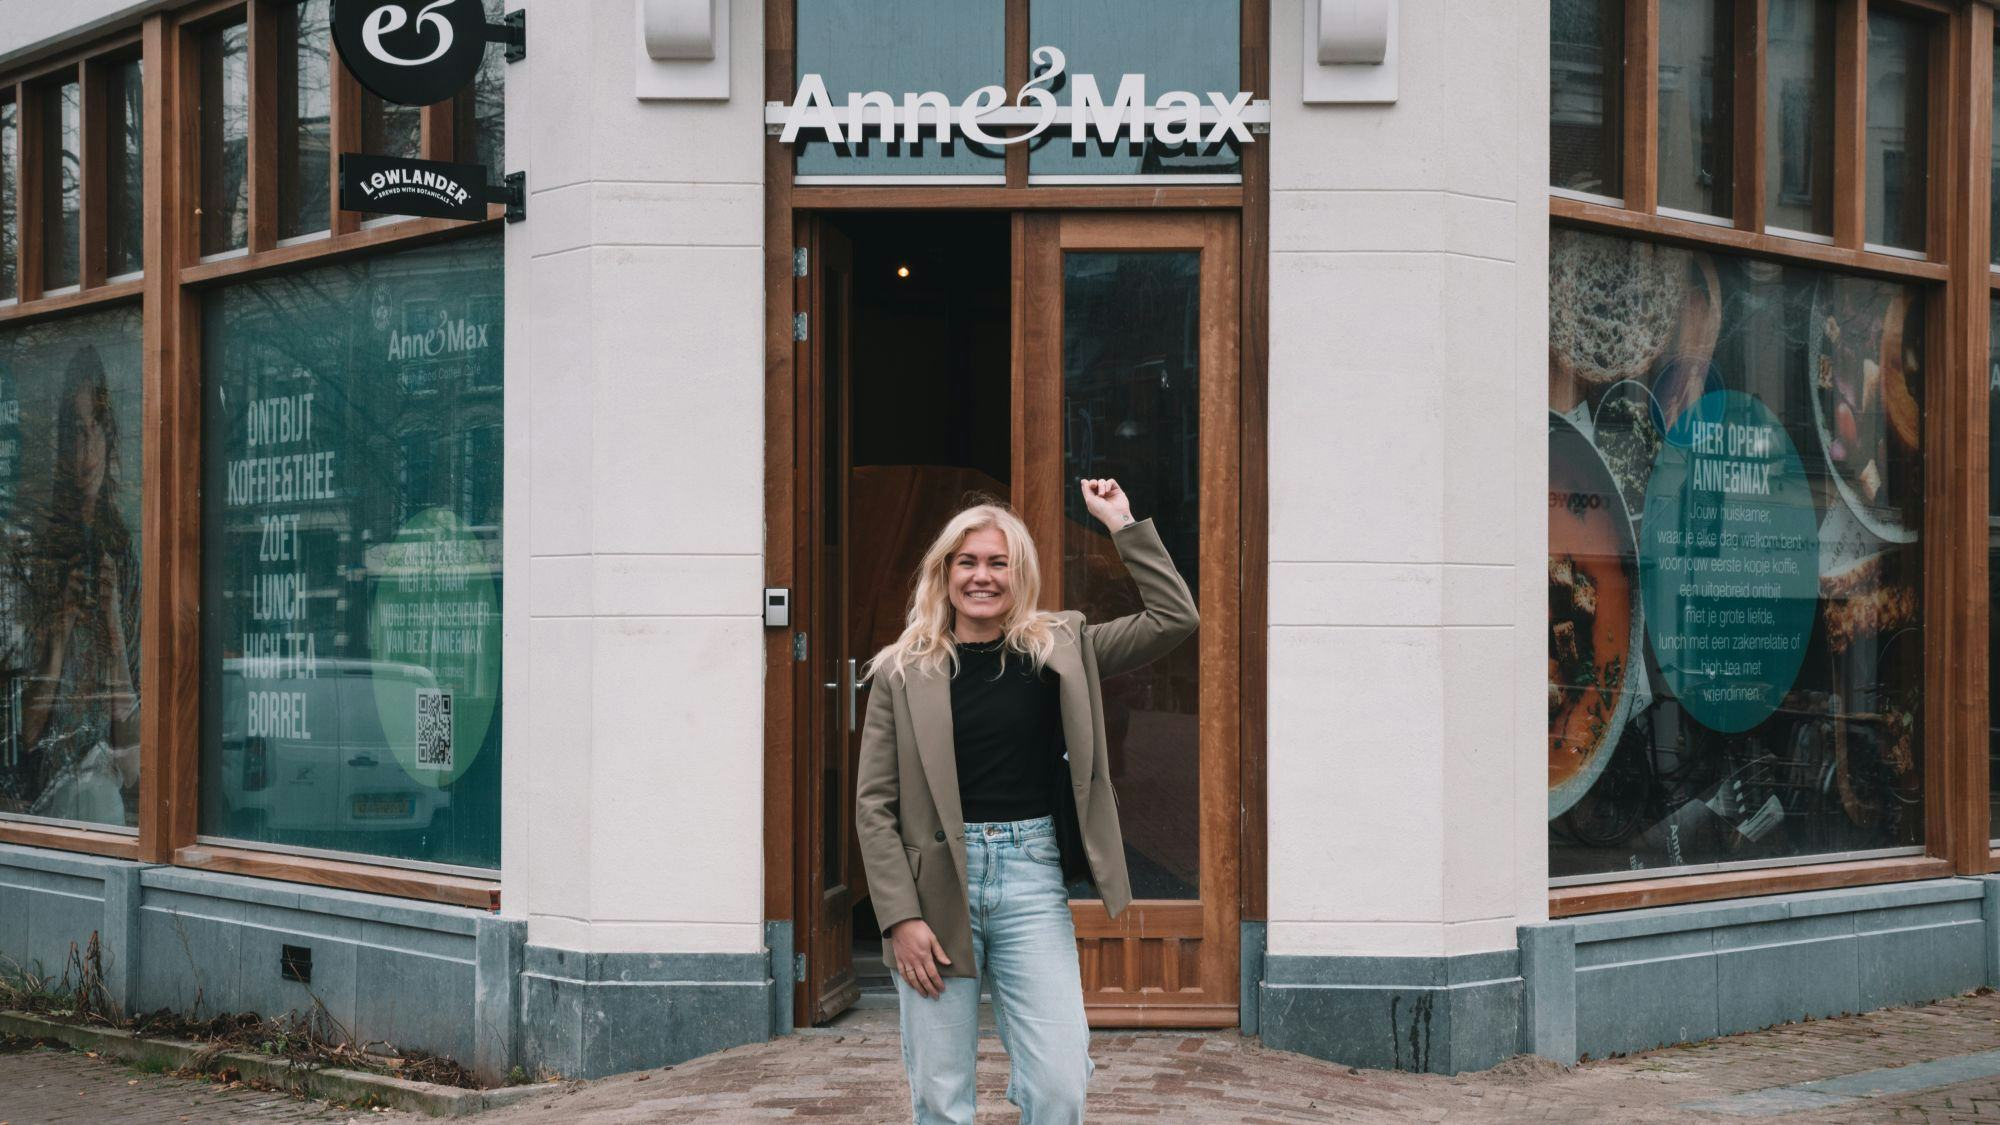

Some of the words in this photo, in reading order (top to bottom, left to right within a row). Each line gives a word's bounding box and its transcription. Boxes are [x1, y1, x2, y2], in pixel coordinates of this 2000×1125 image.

[378, 187, 400, 199] BREWED
[416, 188, 450, 204] BOTANICALS
[248, 393, 314, 447] ONTBIJT
[1692, 420, 1724, 455] HIER
[1728, 424, 1773, 459] OPENT
[228, 451, 335, 506] KOFFIE&THEE
[1693, 458, 1770, 496] ANNE&MAX
[1690, 504, 1717, 520] Jouw
[259, 513, 300, 562] ZOET
[1657, 530, 1682, 545] waar
[1685, 529, 1694, 548] je
[1697, 529, 1717, 546] elke
[1720, 530, 1739, 550] dag
[1741, 532, 1779, 548] welkom
[1659, 557, 1682, 570] voor
[1684, 556, 1708, 575] jouw
[1711, 558, 1741, 573] eerste
[1743, 558, 1770, 577] kopje
[253, 572, 307, 621] LUNCH
[1679, 583, 1699, 597] een
[1701, 582, 1750, 602] uitgebreid
[380, 603, 406, 627] WORD
[408, 601, 490, 627] FRANCHISENEMER
[1686, 608, 1706, 624] met
[1708, 608, 1717, 627] je
[1719, 609, 1745, 628] grote
[386, 630, 404, 654] VAN
[406, 630, 428, 654] DEZE
[431, 629, 482, 654] ANNE&MAX
[1659, 633, 1687, 650] lunch
[1690, 634, 1709, 649] met
[1711, 636, 1730, 650] een
[1732, 633, 1789, 650] zakenrelatie
[1791, 633, 1801, 650] of
[243, 632, 281, 679] HIGH
[285, 632, 317, 680] TEA
[1700, 660, 1721, 680] high
[1724, 660, 1741, 676] tea
[1743, 661, 1762, 676] met
[248, 690, 312, 740] BORREL
